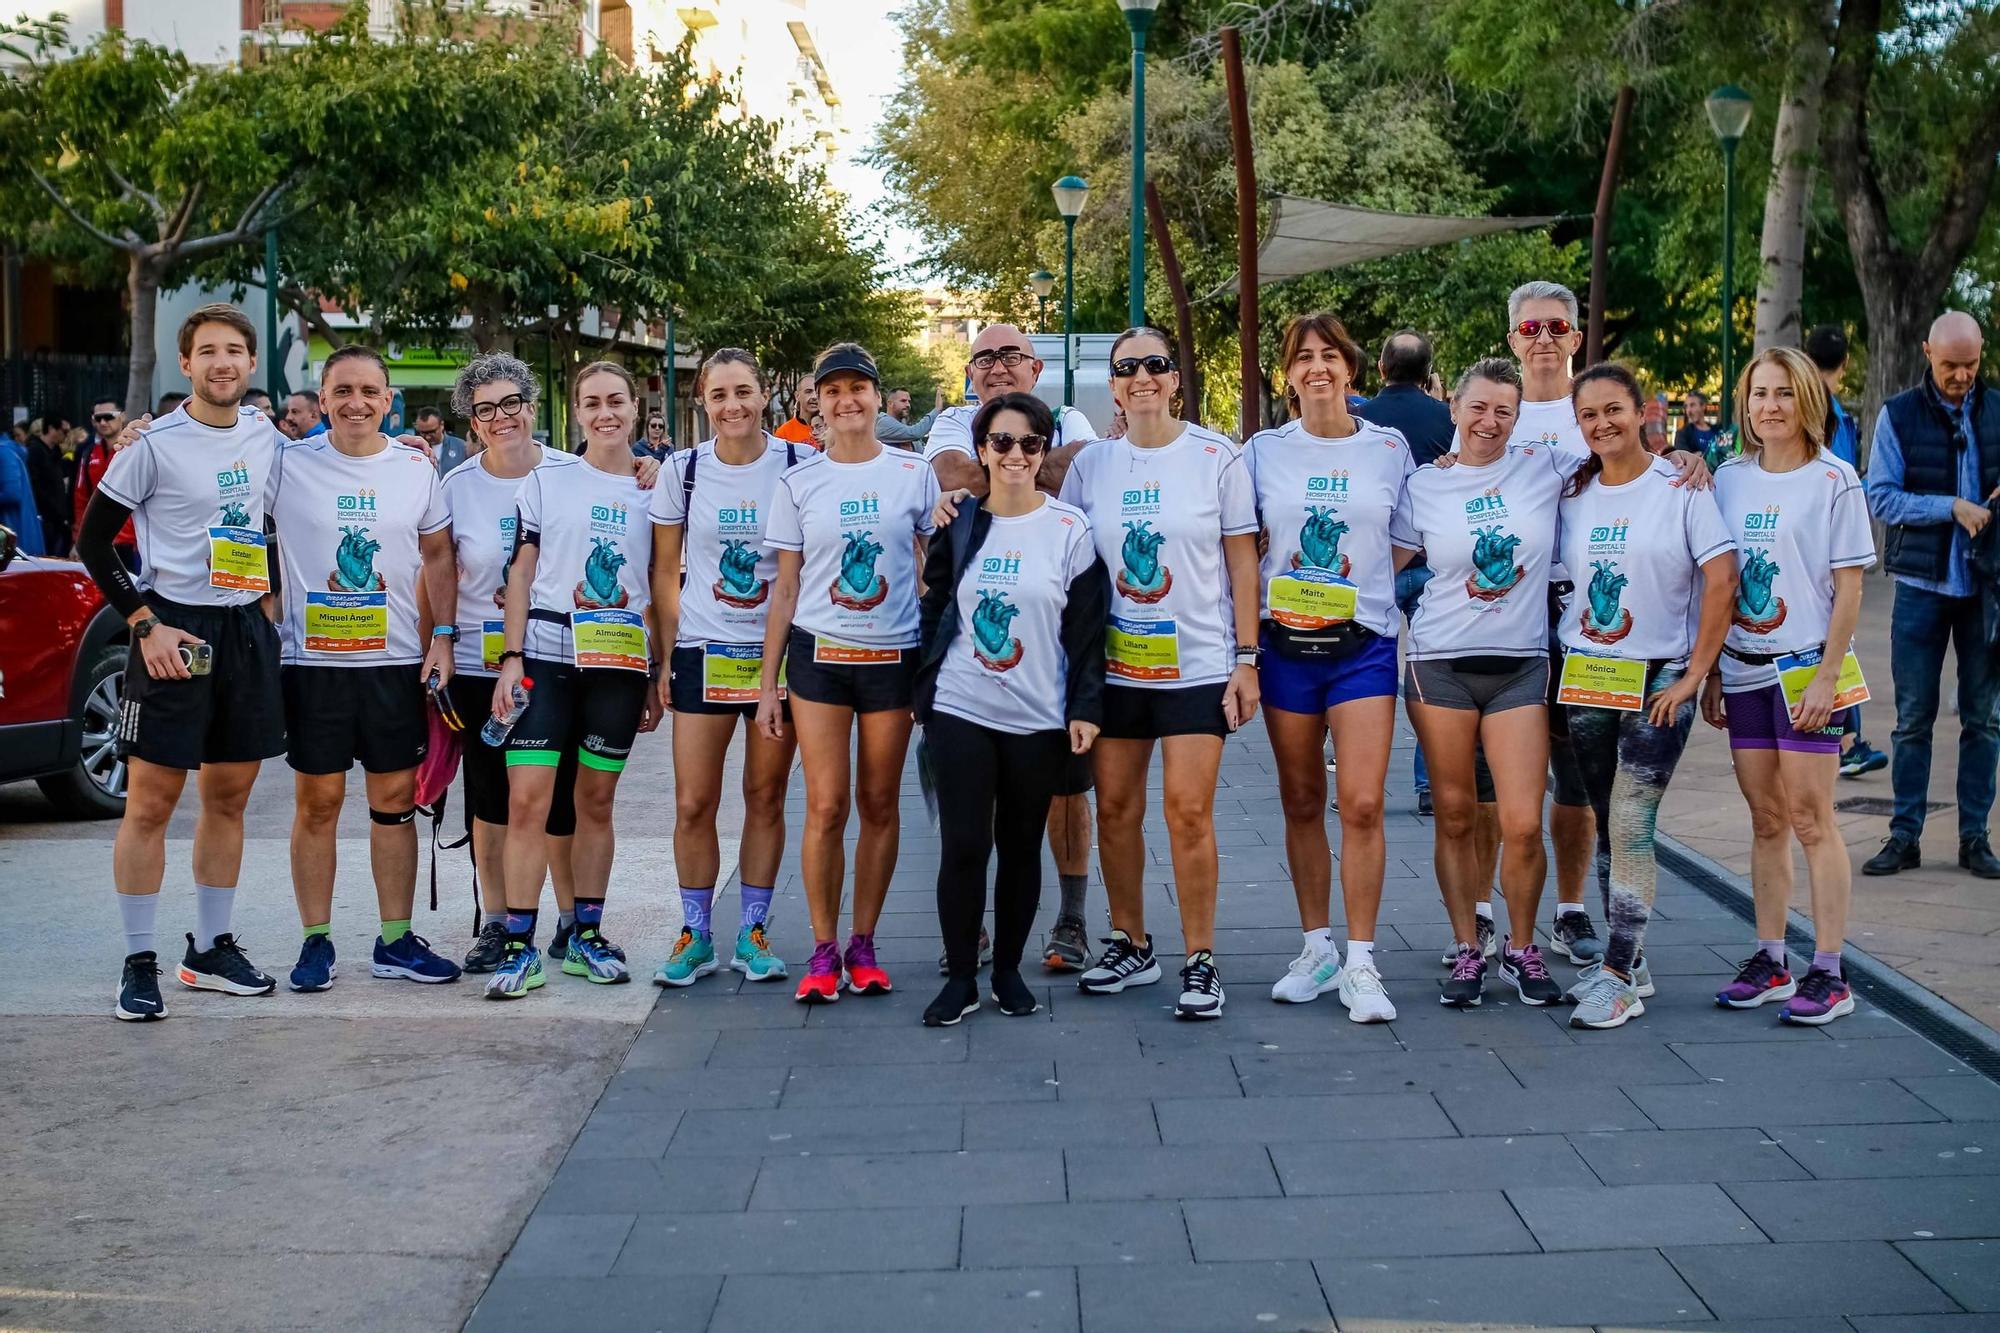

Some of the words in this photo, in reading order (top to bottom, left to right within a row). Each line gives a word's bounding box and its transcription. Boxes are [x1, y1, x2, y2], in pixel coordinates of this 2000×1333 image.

[218, 472, 233, 486] 50
[234, 469, 249, 484] H
[220, 486, 245, 496] HOSPITAL
[1308, 478, 1328, 490] 50
[1330, 478, 1348, 492] H
[338, 496, 356, 509] 50
[359, 496, 376, 510] H
[1123, 491, 1141, 504] 50
[1143, 489, 1160, 503] H
[841, 501, 859, 515] 50
[862, 500, 878, 512] H
[1466, 498, 1484, 513] 50
[1485, 495, 1506, 510] H
[592, 506, 609, 520] 50
[611, 509, 627, 525] H
[720, 510, 737, 523] 50
[740, 510, 758, 523] H
[1467, 510, 1500, 520] HOSPITAL
[1745, 514, 1762, 528] 50
[1764, 514, 1779, 529] H
[501, 518, 516, 530] 50
[590, 521, 620, 531] HOSPITAL
[1590, 527, 1610, 541] 50
[1610, 526, 1628, 541] H
[231, 549, 252, 558] Esteban
[983, 558, 1001, 572] 50
[1002, 559, 1021, 573] H
[1300, 588, 1325, 597] Maite
[350, 612, 374, 621] Ángel
[596, 630, 632, 638] Almudena
[1124, 640, 1148, 649] Liliana
[1586, 664, 1616, 673] Mónica
